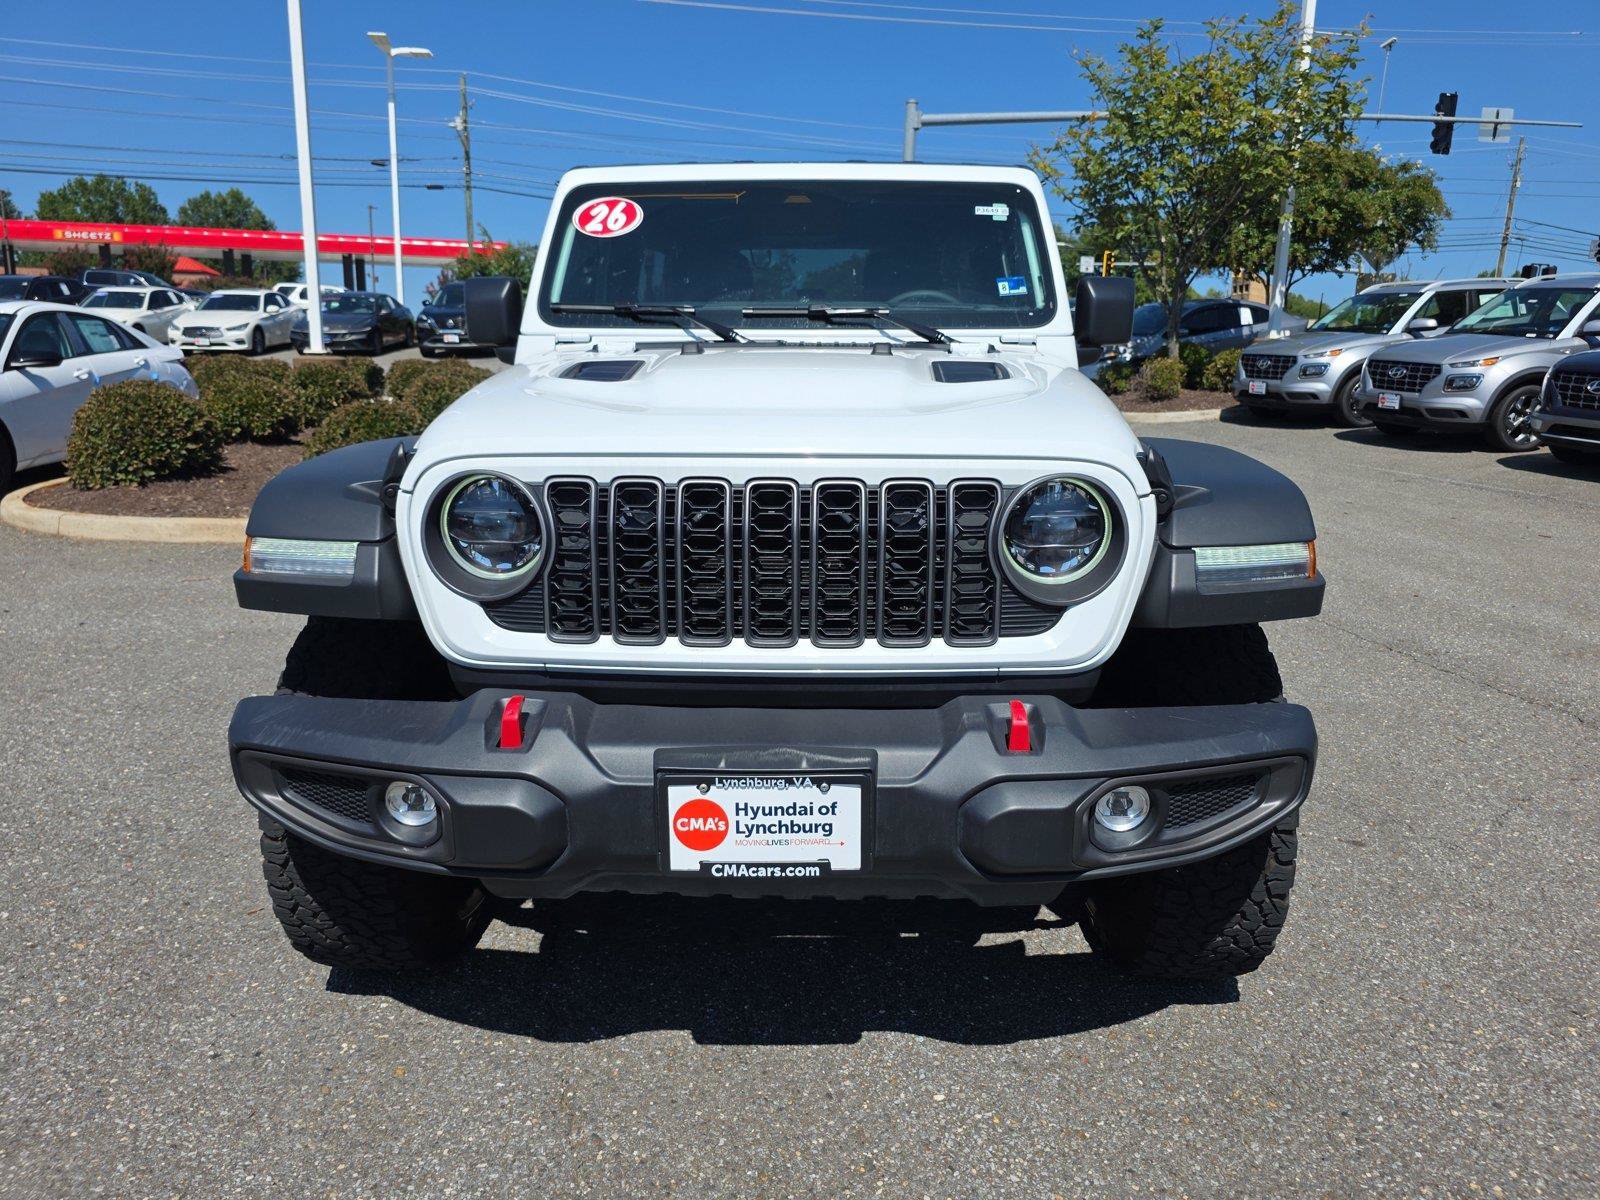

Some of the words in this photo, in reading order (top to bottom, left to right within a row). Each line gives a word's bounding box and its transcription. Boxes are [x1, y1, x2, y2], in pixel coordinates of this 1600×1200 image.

[584, 201, 627, 232] 26
[64, 230, 112, 240] SHEETZ
[715, 777, 788, 791] Lynchburg,
[793, 777, 813, 788] VA
[735, 801, 813, 819] Hyundai
[817, 801, 838, 816] of
[676, 817, 727, 832] CMA's
[735, 819, 833, 838] Lynchburg
[711, 863, 820, 877] CMAcars.com
